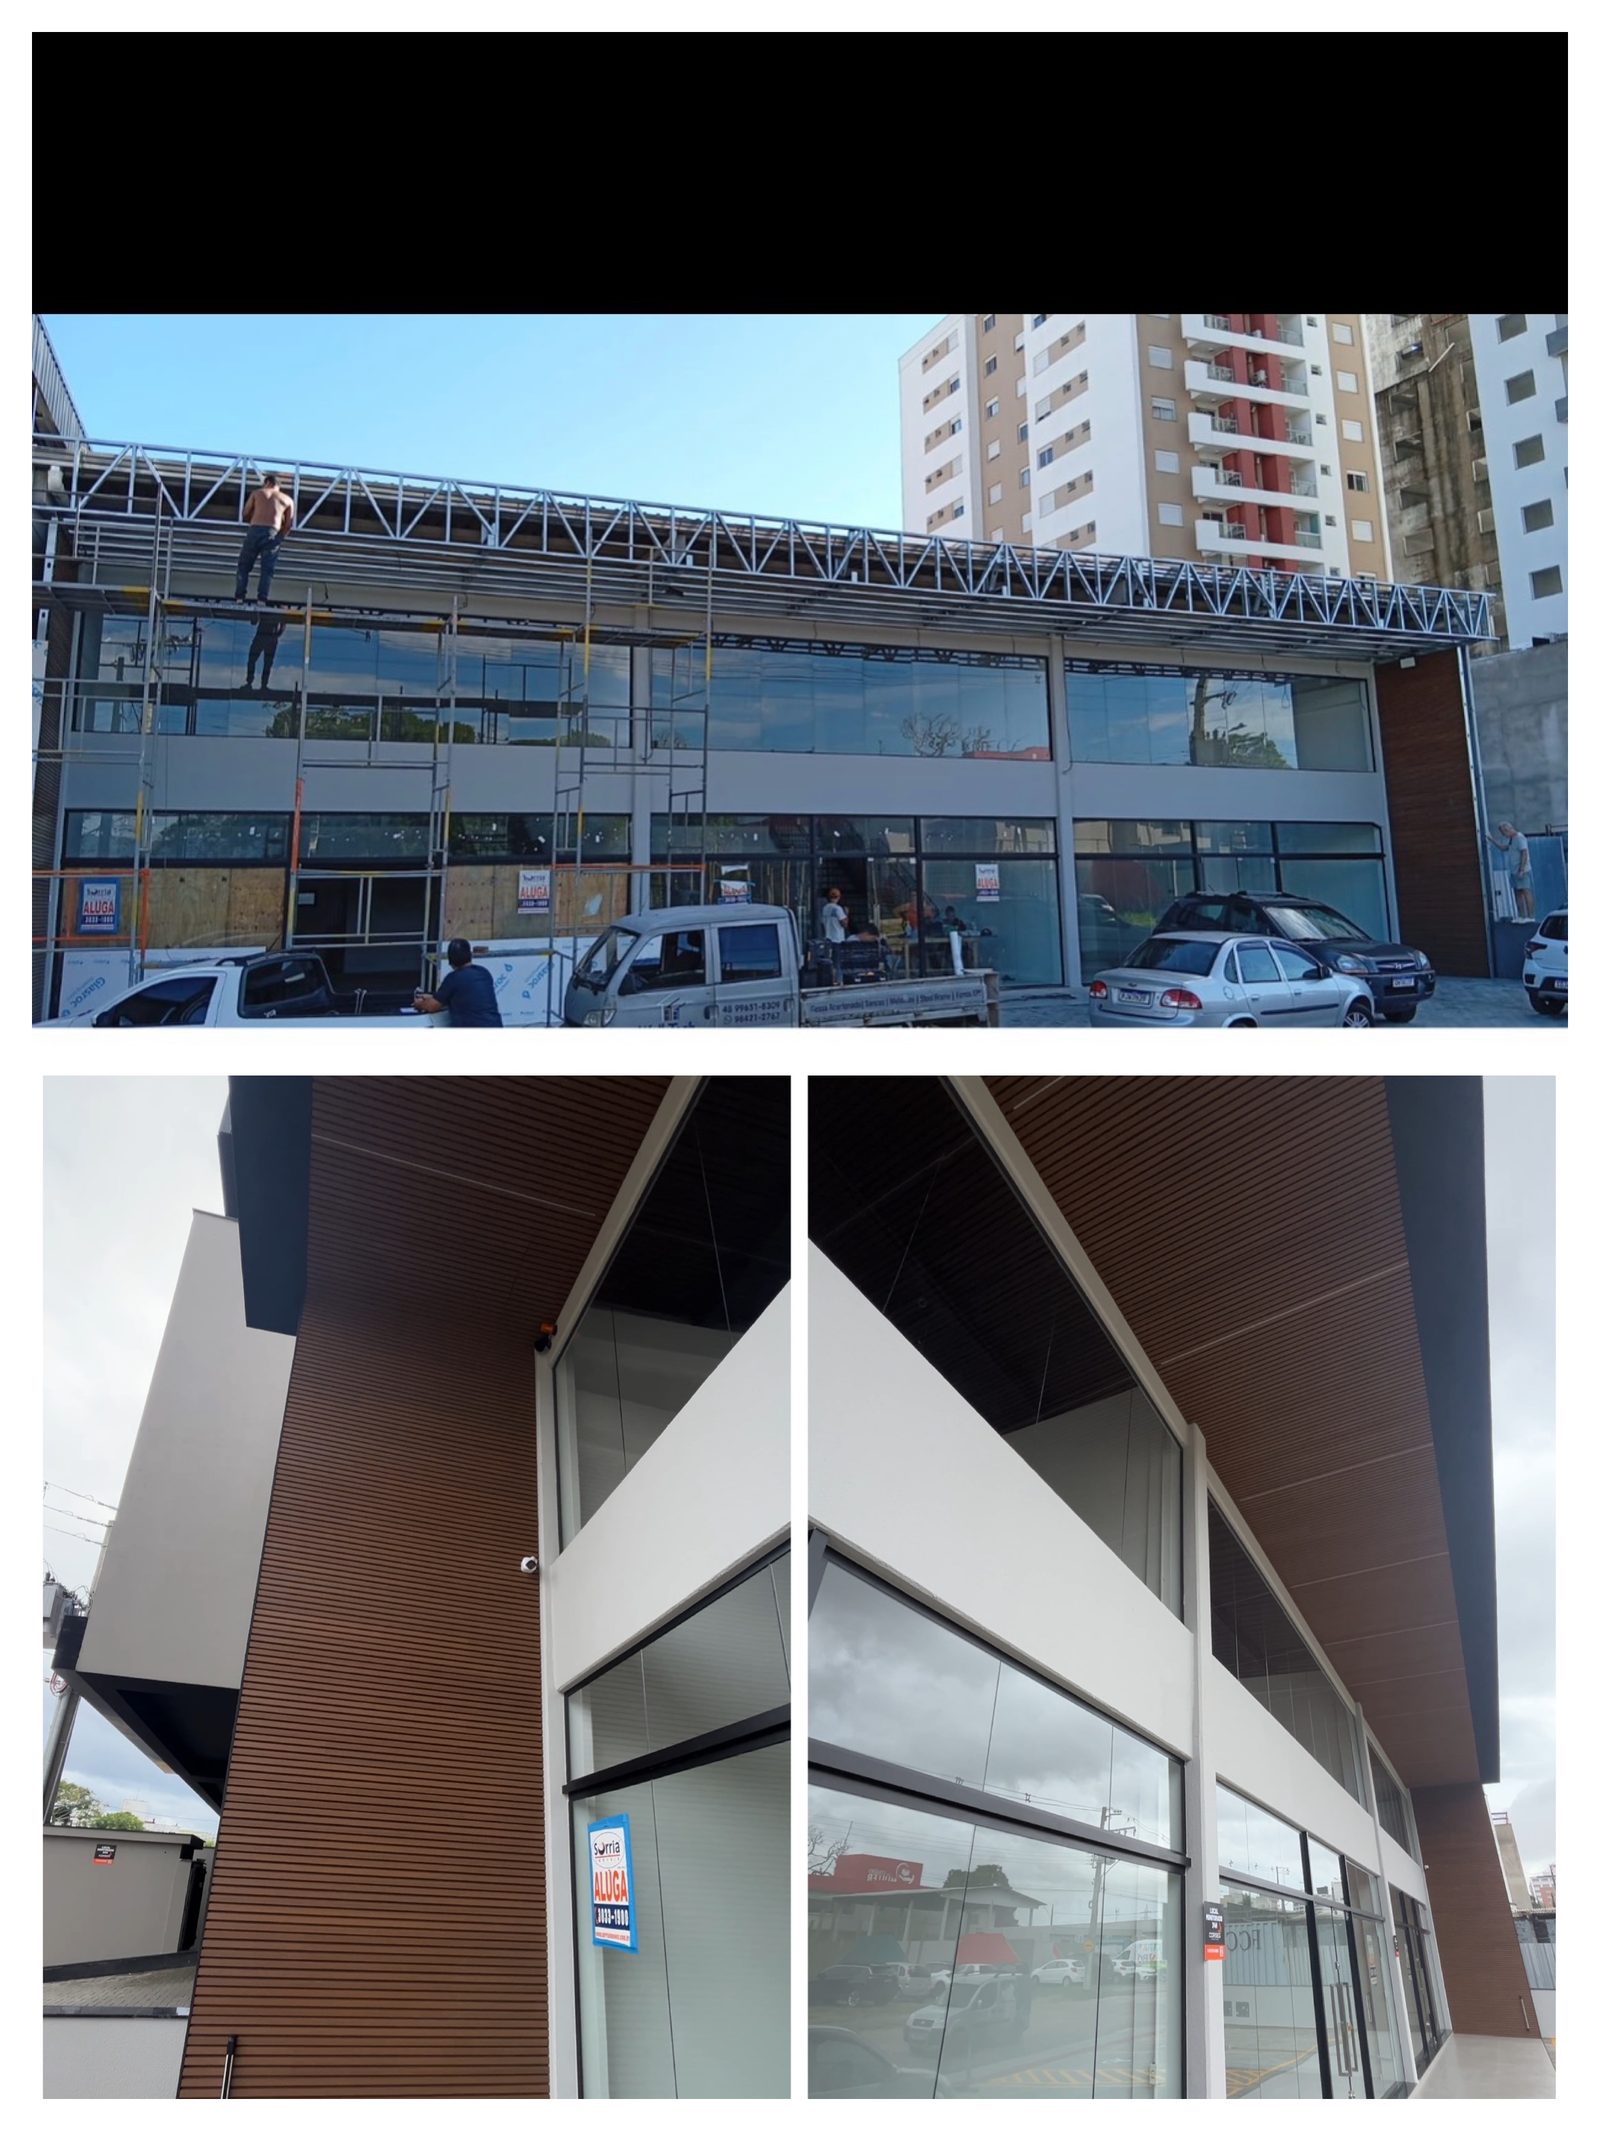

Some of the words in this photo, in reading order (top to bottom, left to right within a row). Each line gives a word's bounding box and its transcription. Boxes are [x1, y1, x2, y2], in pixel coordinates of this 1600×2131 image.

[521, 885, 548, 898] ALUGA
[84, 901, 113, 914] ALUGA
[70, 976, 105, 1007] Glasroc
[595, 1871, 628, 1902] ALUGA
